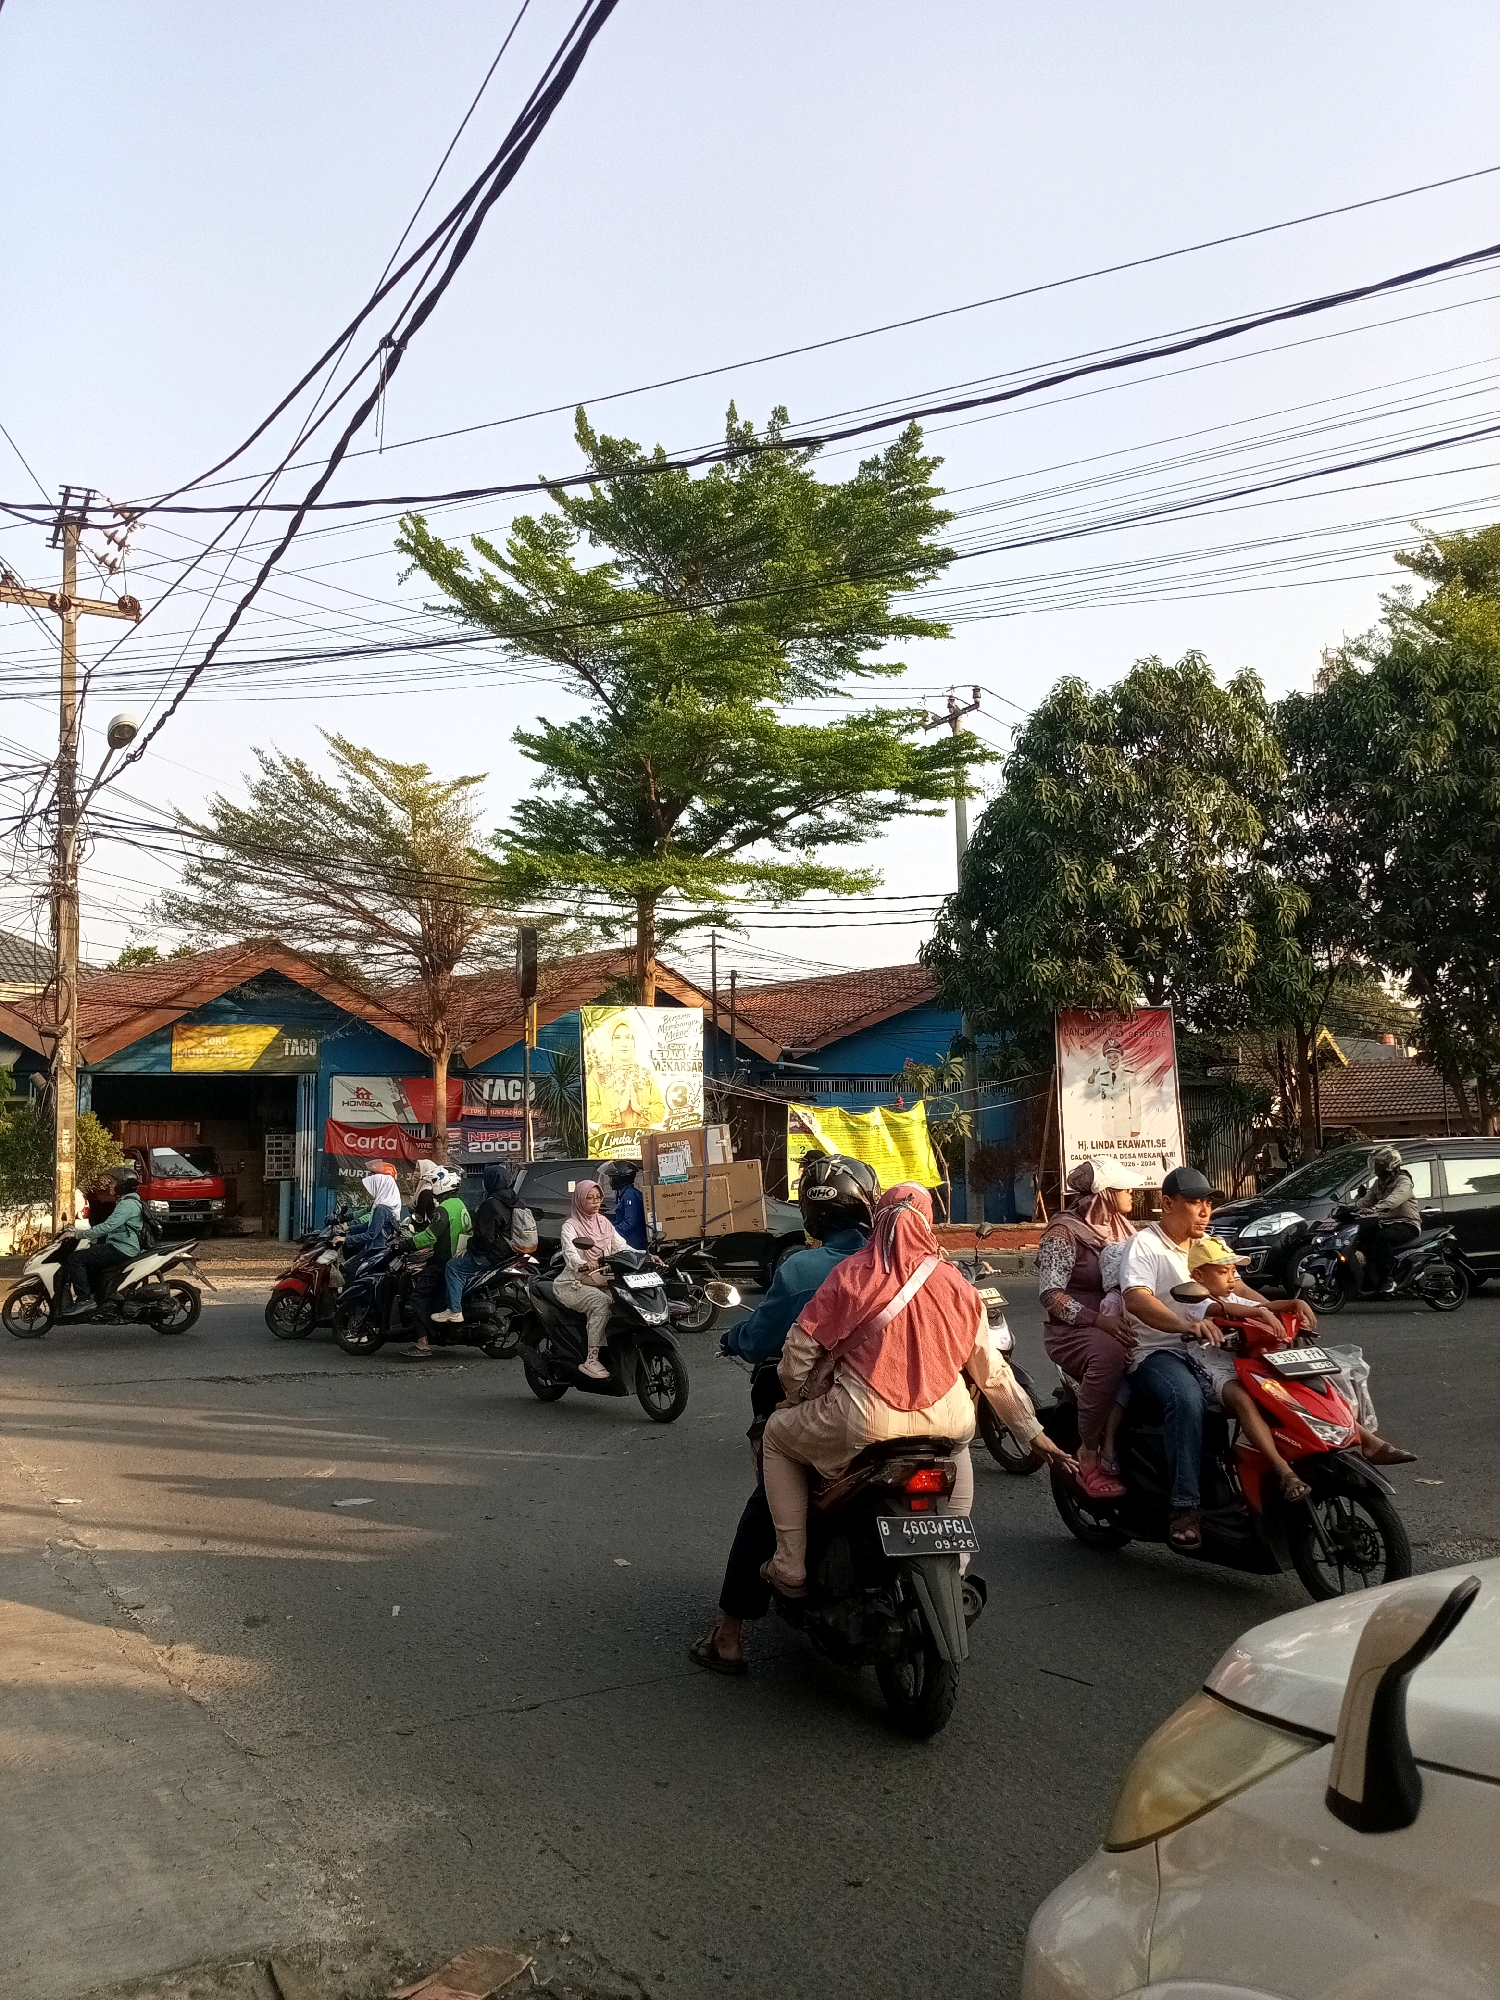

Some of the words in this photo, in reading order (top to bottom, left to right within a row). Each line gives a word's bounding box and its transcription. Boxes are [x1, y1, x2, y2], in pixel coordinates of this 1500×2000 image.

[203, 1036, 228, 1046] TOKO
[282, 1038, 317, 1056] TACO
[652, 1061, 703, 1072] MEKARSAR
[482, 1078, 537, 1101] TACO
[671, 1085, 688, 1108] 3
[343, 1132, 398, 1151] Carta
[468, 1140, 522, 1153] 2000
[601, 1132, 632, 1152] Linda
[1077, 1140, 1088, 1151] Hj.
[1090, 1140, 1115, 1150] LINDA
[1117, 1139, 1167, 1149] EKAWATI.SE
[799, 1145, 806, 1155] 2
[1119, 1152, 1137, 1160] DESA
[1138, 1151, 1176, 1159] MEKARARI
[661, 1191, 684, 1199] SHARP
[1268, 1355, 1278, 1364] B
[1274, 1431, 1302, 1449] HONDA
[880, 1520, 891, 1536] B
[902, 1520, 938, 1535] 4603
[942, 1519, 972, 1534] FGL
